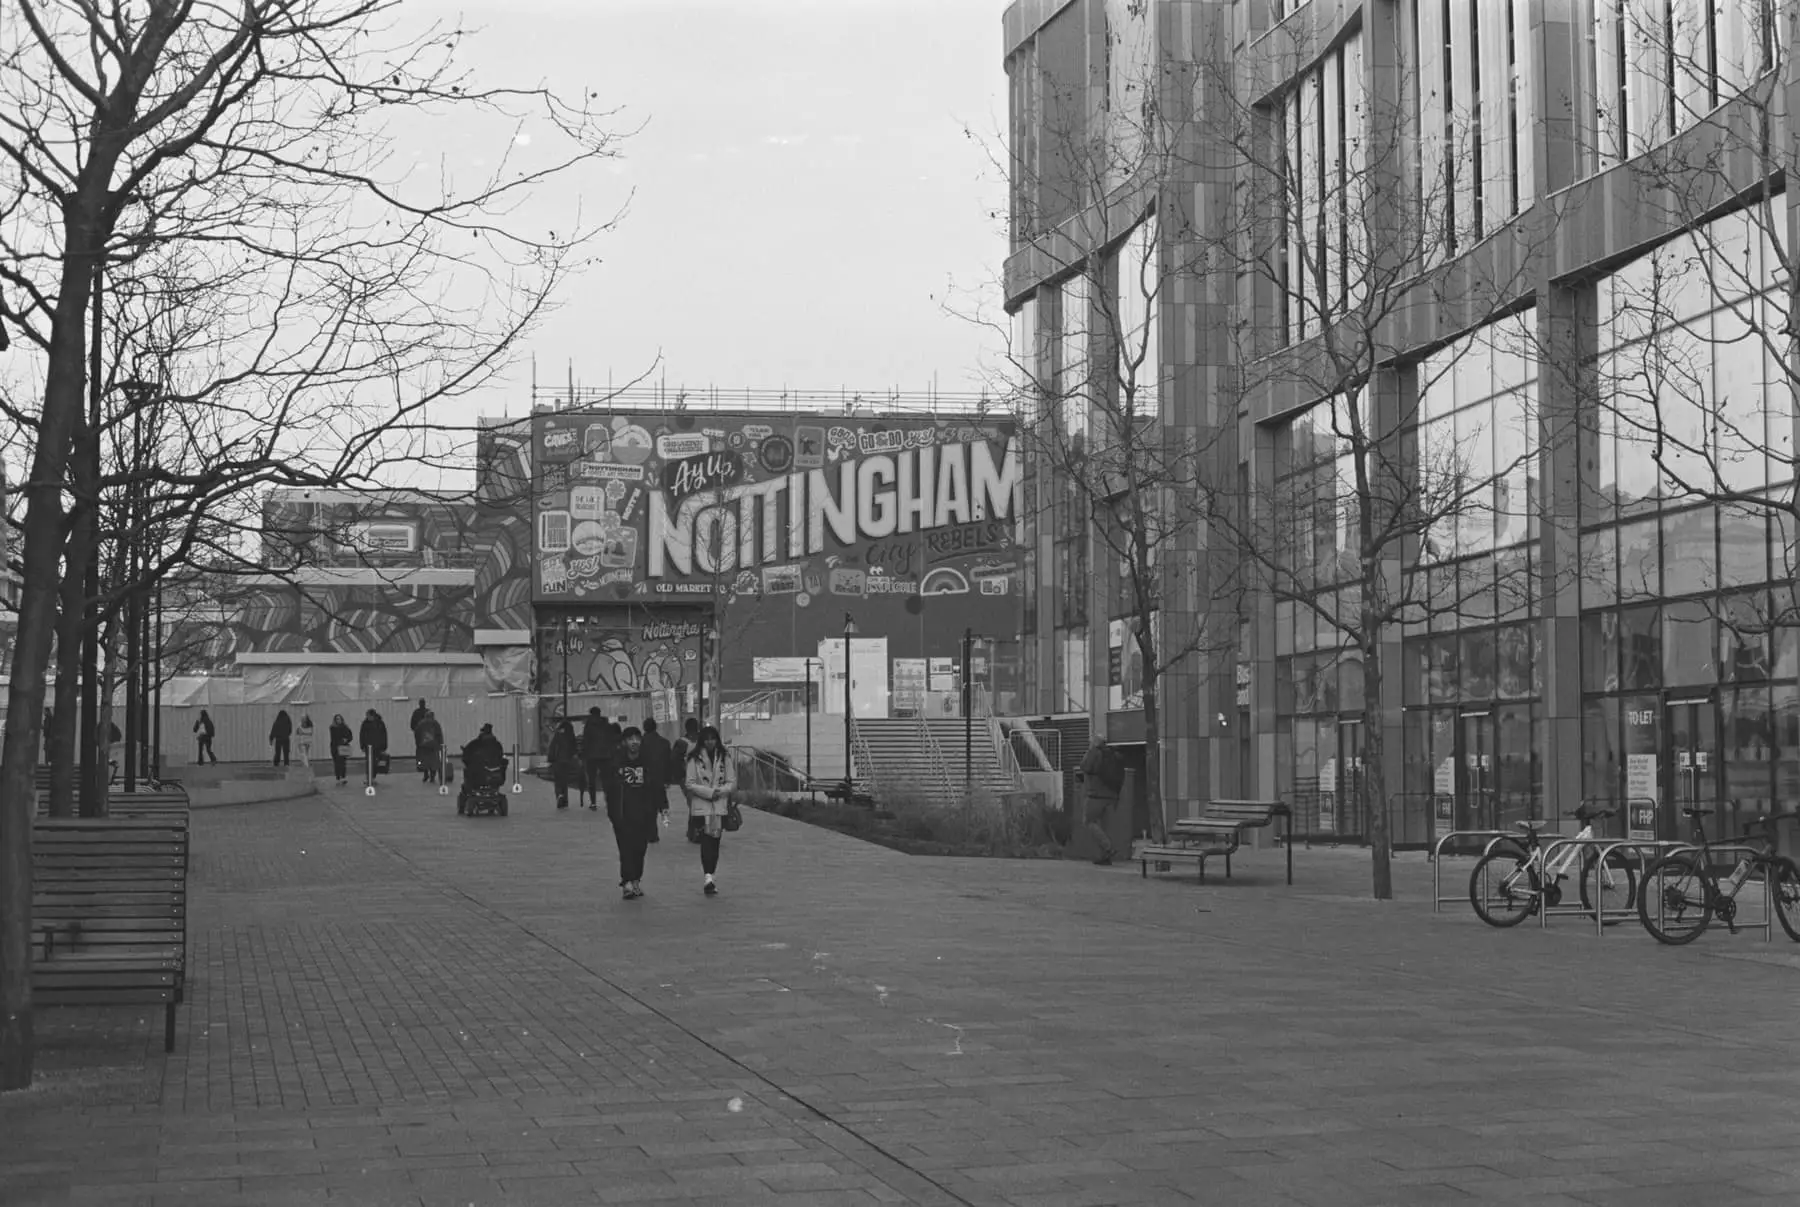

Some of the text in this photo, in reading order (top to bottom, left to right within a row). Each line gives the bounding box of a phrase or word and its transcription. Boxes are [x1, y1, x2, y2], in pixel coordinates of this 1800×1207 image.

[670, 460, 707, 496] Ay
[648, 435, 1024, 577] NOTTINGHAM
[927, 523, 1000, 553] REBELS
[655, 583, 673, 593] OLD
[675, 583, 713, 593] MARKET
[642, 619, 706, 643] Nottingha
[1628, 709, 1654, 725] TO LET
[1639, 808, 1655, 825] FHP
